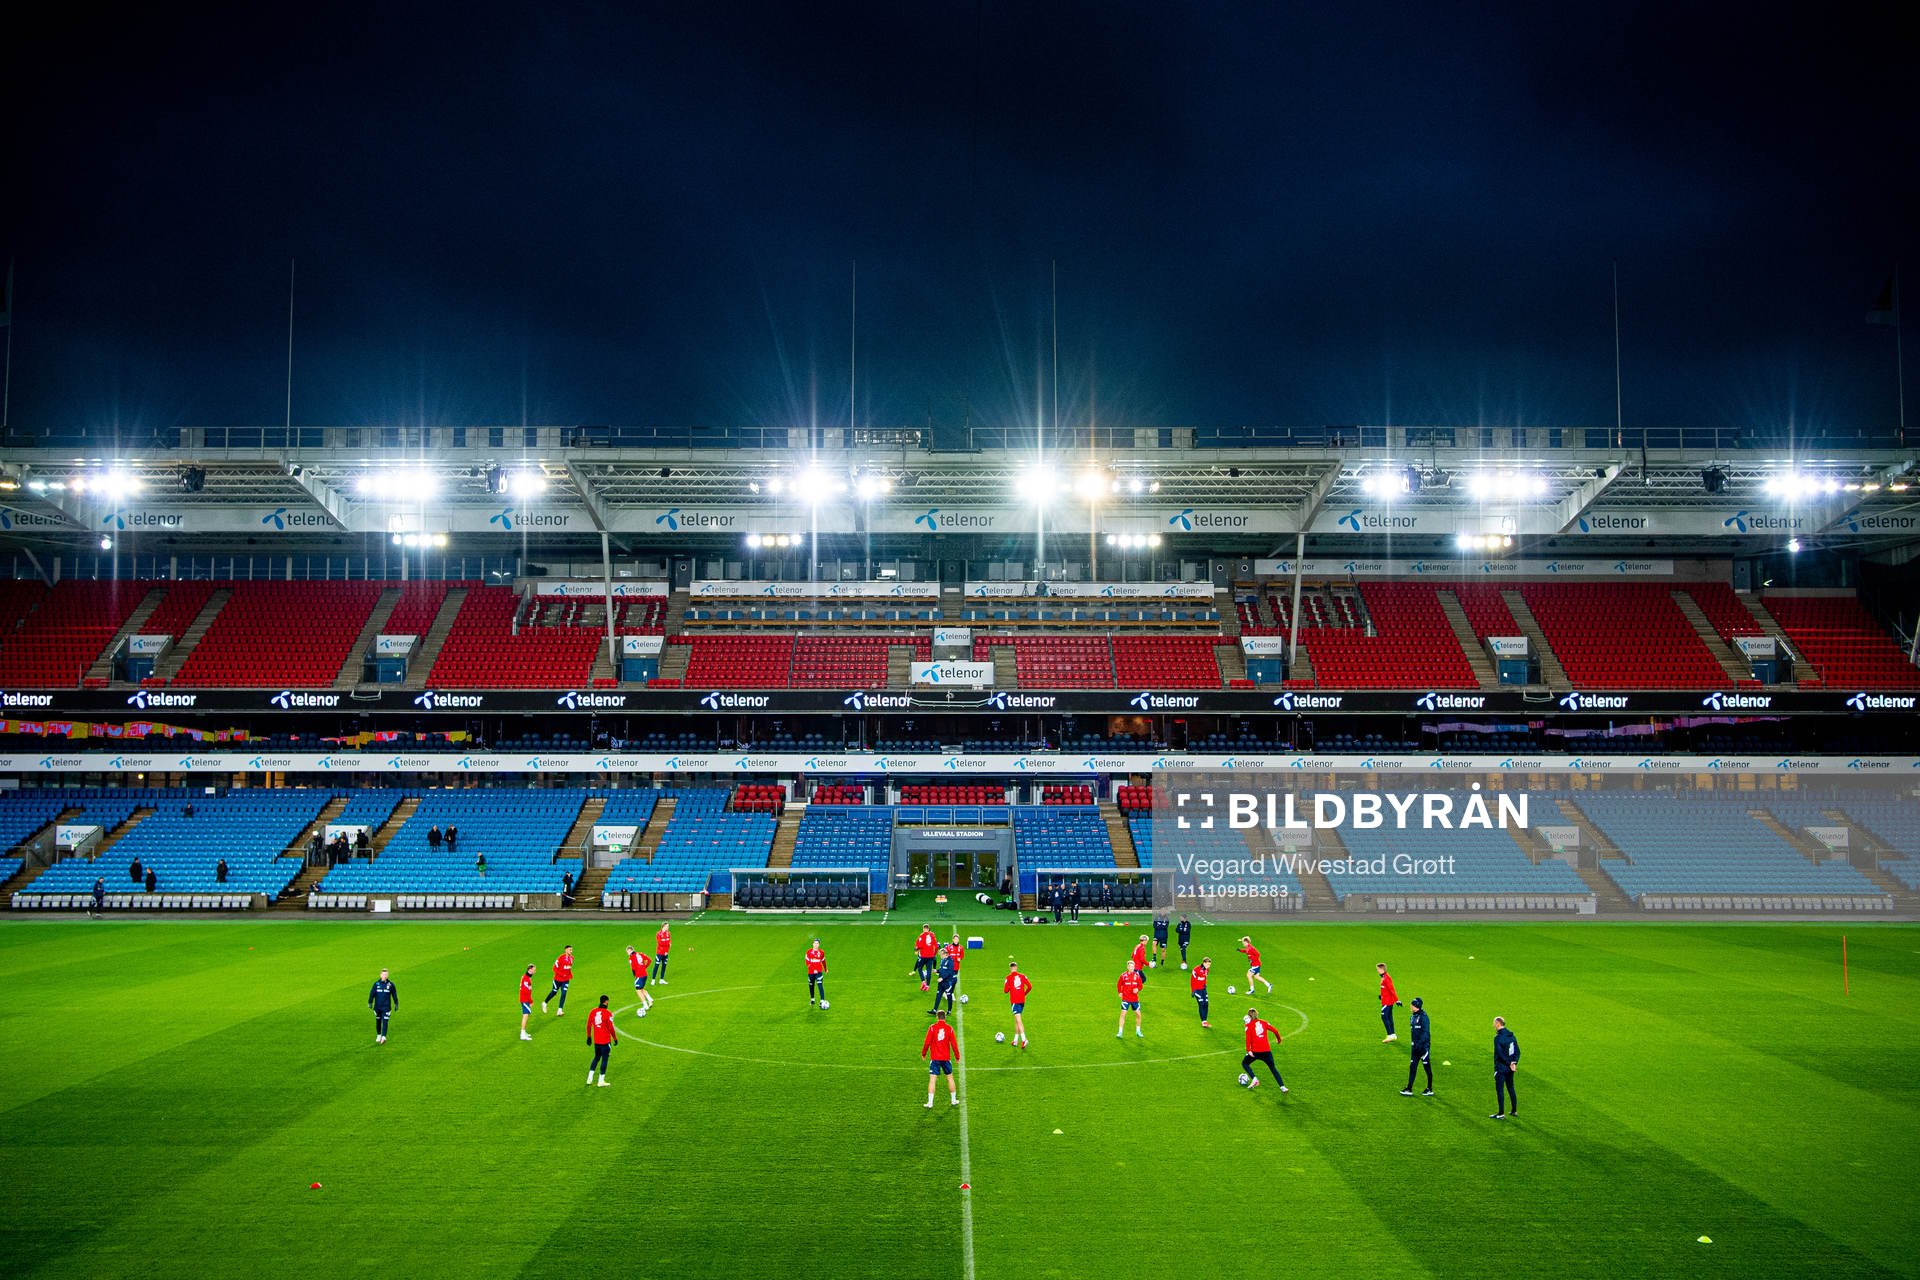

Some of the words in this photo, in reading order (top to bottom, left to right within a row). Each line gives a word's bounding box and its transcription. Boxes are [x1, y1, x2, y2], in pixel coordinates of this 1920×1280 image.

[14, 512, 65, 525] teleno
[128, 511, 183, 525] telenor
[287, 512, 334, 526] teleno
[515, 512, 569, 526] telenor
[680, 513, 735, 526] telenor
[940, 513, 994, 527] telenor
[1194, 513, 1249, 527] telenor
[1363, 513, 1417, 527] telenor
[1592, 515, 1646, 529] telenor
[1749, 515, 1804, 529] telenor
[1862, 515, 1916, 529] telenor
[1355, 562, 1382, 571] telenor
[1422, 562, 1449, 571] telenor
[1489, 562, 1517, 571] telenor
[1557, 562, 1584, 571] telenor
[1624, 562, 1652, 571] telenor
[565, 585, 593, 594] telenor
[625, 585, 653, 594] telenor
[711, 585, 739, 594] telenor
[775, 585, 803, 594] telenor
[901, 585, 929, 594] telenor
[985, 585, 1013, 594] telenor
[946, 632, 970, 640] telenor
[637, 640, 661, 648] telenor
[1254, 640, 1278, 648] telenor
[1500, 641, 1524, 649] telenor
[1747, 641, 1772, 650] telenor
[940, 667, 984, 679] telenor
[3, 693, 52, 706] telenor
[147, 693, 196, 706] telenor
[290, 693, 340, 706] telenor
[434, 693, 483, 706] telenor
[577, 693, 626, 706] telenor
[720, 694, 769, 707] telenor
[863, 694, 912, 707] telenor
[1007, 694, 1055, 707] telenor
[1150, 694, 1199, 707] telenor
[1293, 694, 1342, 707] telenor
[1436, 694, 1485, 707] telenor
[1579, 695, 1628, 708] telenor
[1722, 695, 1771, 708] telenor
[1866, 695, 1915, 708] telenor
[52, 759, 82, 767] telenor
[122, 759, 152, 767] telenor
[191, 759, 221, 767] telenor
[261, 759, 291, 767] telenor
[330, 759, 360, 767] telenor
[400, 759, 430, 767] telenor
[469, 759, 499, 767] telenor
[539, 759, 569, 767] telenor
[608, 760, 638, 768] telenor
[678, 760, 708, 768] telenor
[747, 760, 778, 768] telenor
[817, 760, 847, 768] telenor
[886, 760, 917, 768] telenor
[956, 760, 986, 768] telenor
[1026, 760, 1056, 768] telenor
[1095, 760, 1125, 768] telenor
[1164, 760, 1195, 768] telenor
[1234, 760, 1264, 768] telenor
[1303, 760, 1333, 768] telenor
[1373, 760, 1403, 768] telenor
[1442, 760, 1472, 768] telenor
[1512, 760, 1542, 768] telenor
[1581, 760, 1611, 768] telenor
[1650, 760, 1681, 768] telenor
[1720, 760, 1750, 768] telenor
[1789, 760, 1819, 768] telenor
[1860, 760, 1890, 768] telenor
[1283, 832, 1308, 840] telenor
[1550, 832, 1575, 840] telenor
